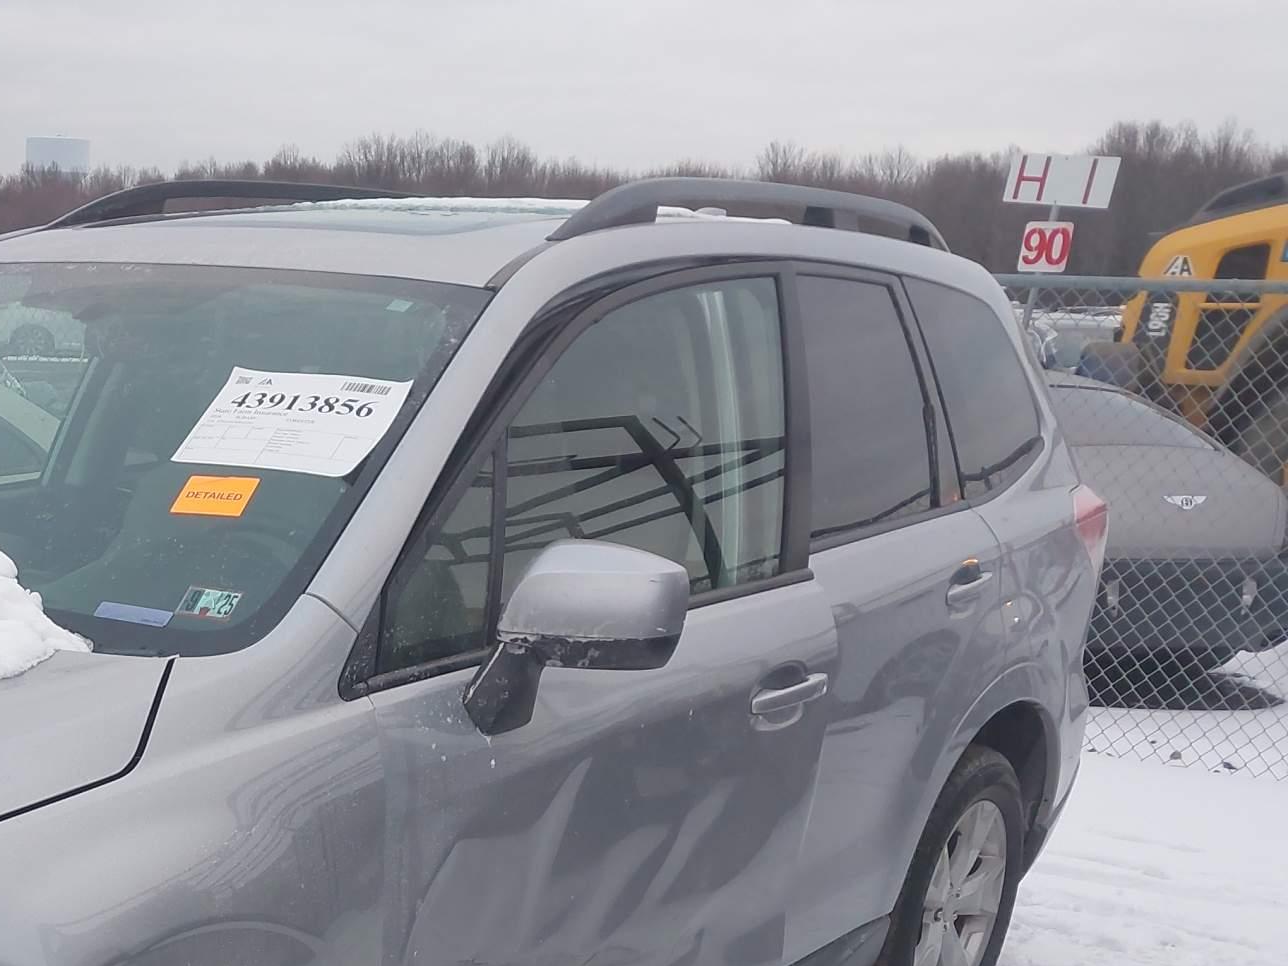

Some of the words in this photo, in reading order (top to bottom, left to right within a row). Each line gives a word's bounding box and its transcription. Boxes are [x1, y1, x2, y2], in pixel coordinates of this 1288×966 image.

[1012, 155, 1053, 201] H
[1021, 227, 1071, 266] 90
[230, 391, 380, 418] 43913856
[185, 491, 243, 501] DETAILED
[216, 593, 239, 616] 25
